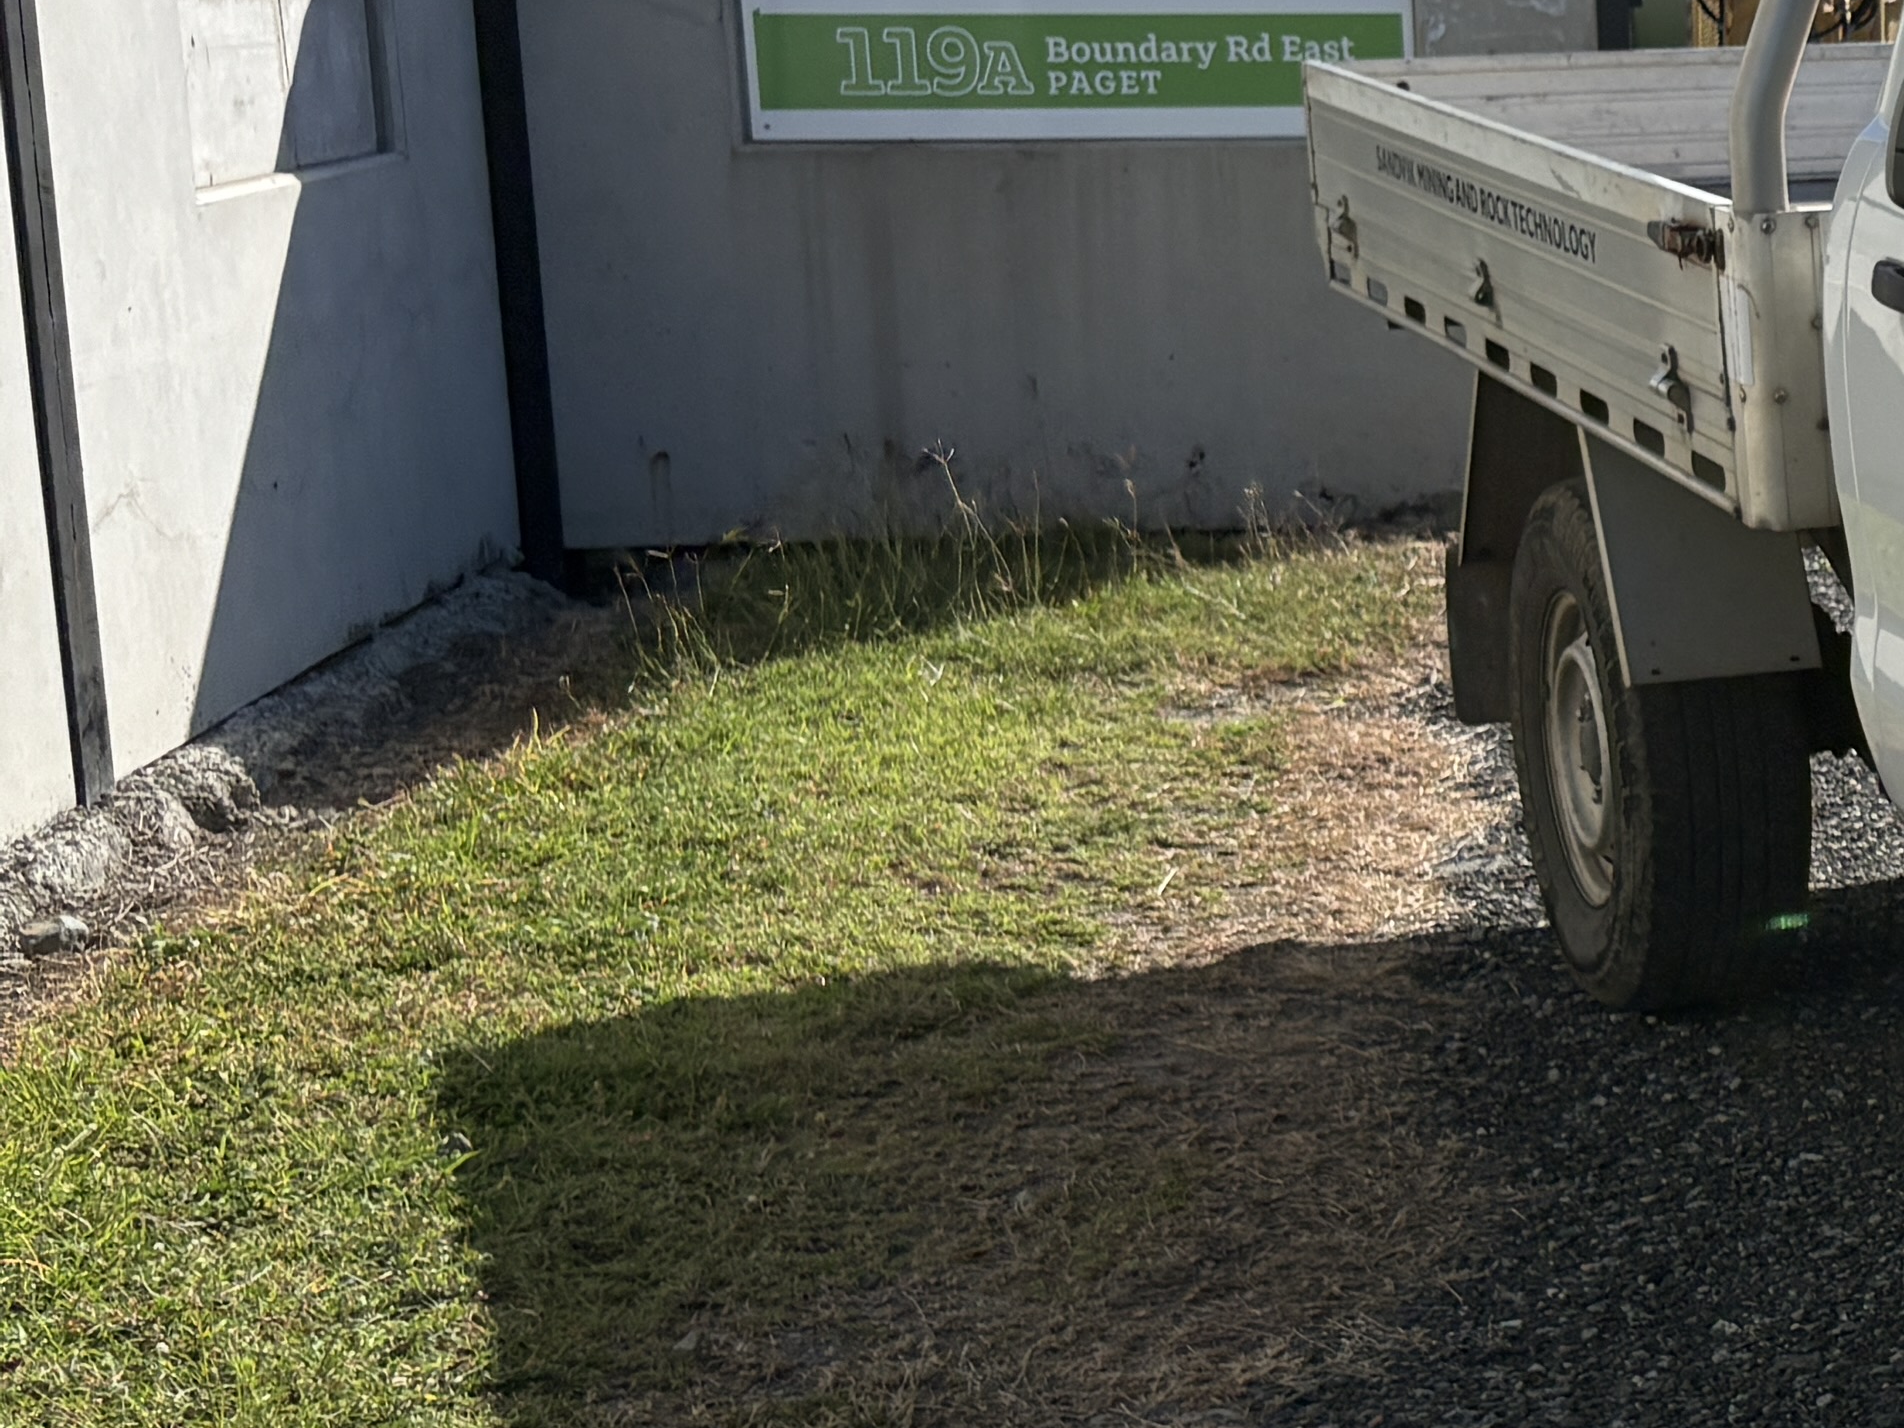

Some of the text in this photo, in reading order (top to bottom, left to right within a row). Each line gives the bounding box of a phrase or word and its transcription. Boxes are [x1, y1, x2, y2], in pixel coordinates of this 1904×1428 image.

[835, 25, 1355, 98] 119A Boundary Rd East
[1047, 71, 1162, 96] PAGET
[1455, 177, 1478, 214] AND
[1479, 188, 1511, 228] ROCK
[1510, 200, 1597, 264] TECHNOLOGY
